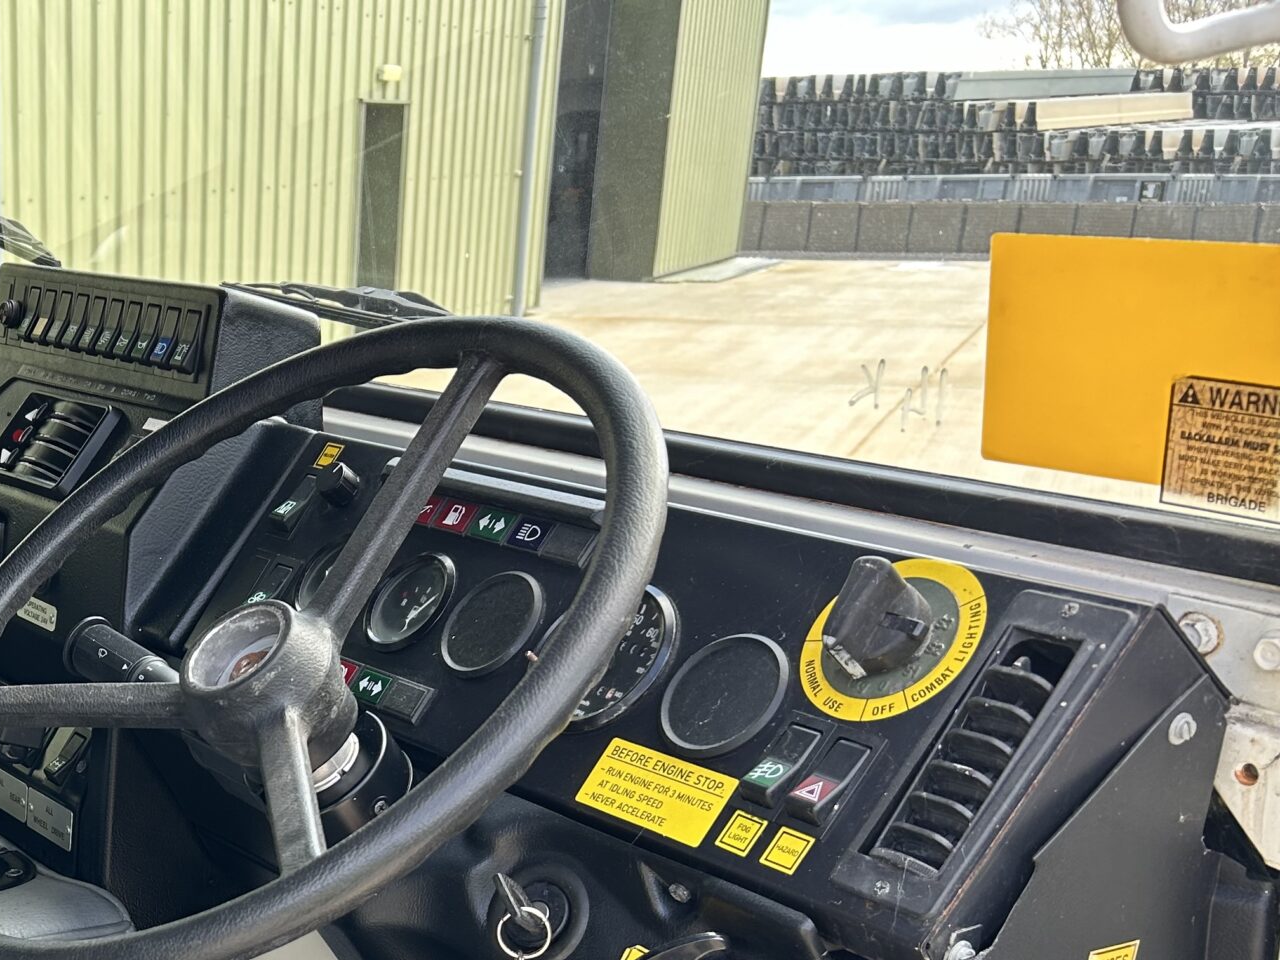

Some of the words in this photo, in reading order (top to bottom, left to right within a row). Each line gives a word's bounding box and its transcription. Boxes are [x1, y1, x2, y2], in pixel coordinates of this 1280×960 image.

[1210, 386, 1280, 416] WARN
[1207, 492, 1267, 513] BRIGADE
[910, 666, 955, 703] COMBAT
[953, 601, 982, 664] LIGHTING
[805, 659, 824, 698] NORMAL
[822, 696, 844, 712] USE
[871, 703, 896, 716] OFF
[611, 745, 653, 768] BEFORE
[652, 760, 694, 782] ENGINE
[597, 779, 609, 789] AT
[609, 783, 635, 799] IDLING
[636, 793, 664, 810] SPEED
[606, 766, 622, 779] RUN
[622, 772, 655, 791] ENGINE
[654, 784, 670, 796] FOR
[669, 789, 676, 798] 3
[675, 792, 714, 812] MINUTES
[590, 792, 618, 808] NEVER
[616, 802, 667, 827] ACCELERATE
[727, 831, 748, 844] LIGHT
[737, 823, 752, 833] FOG
[776, 844, 800, 857] HAZARD
